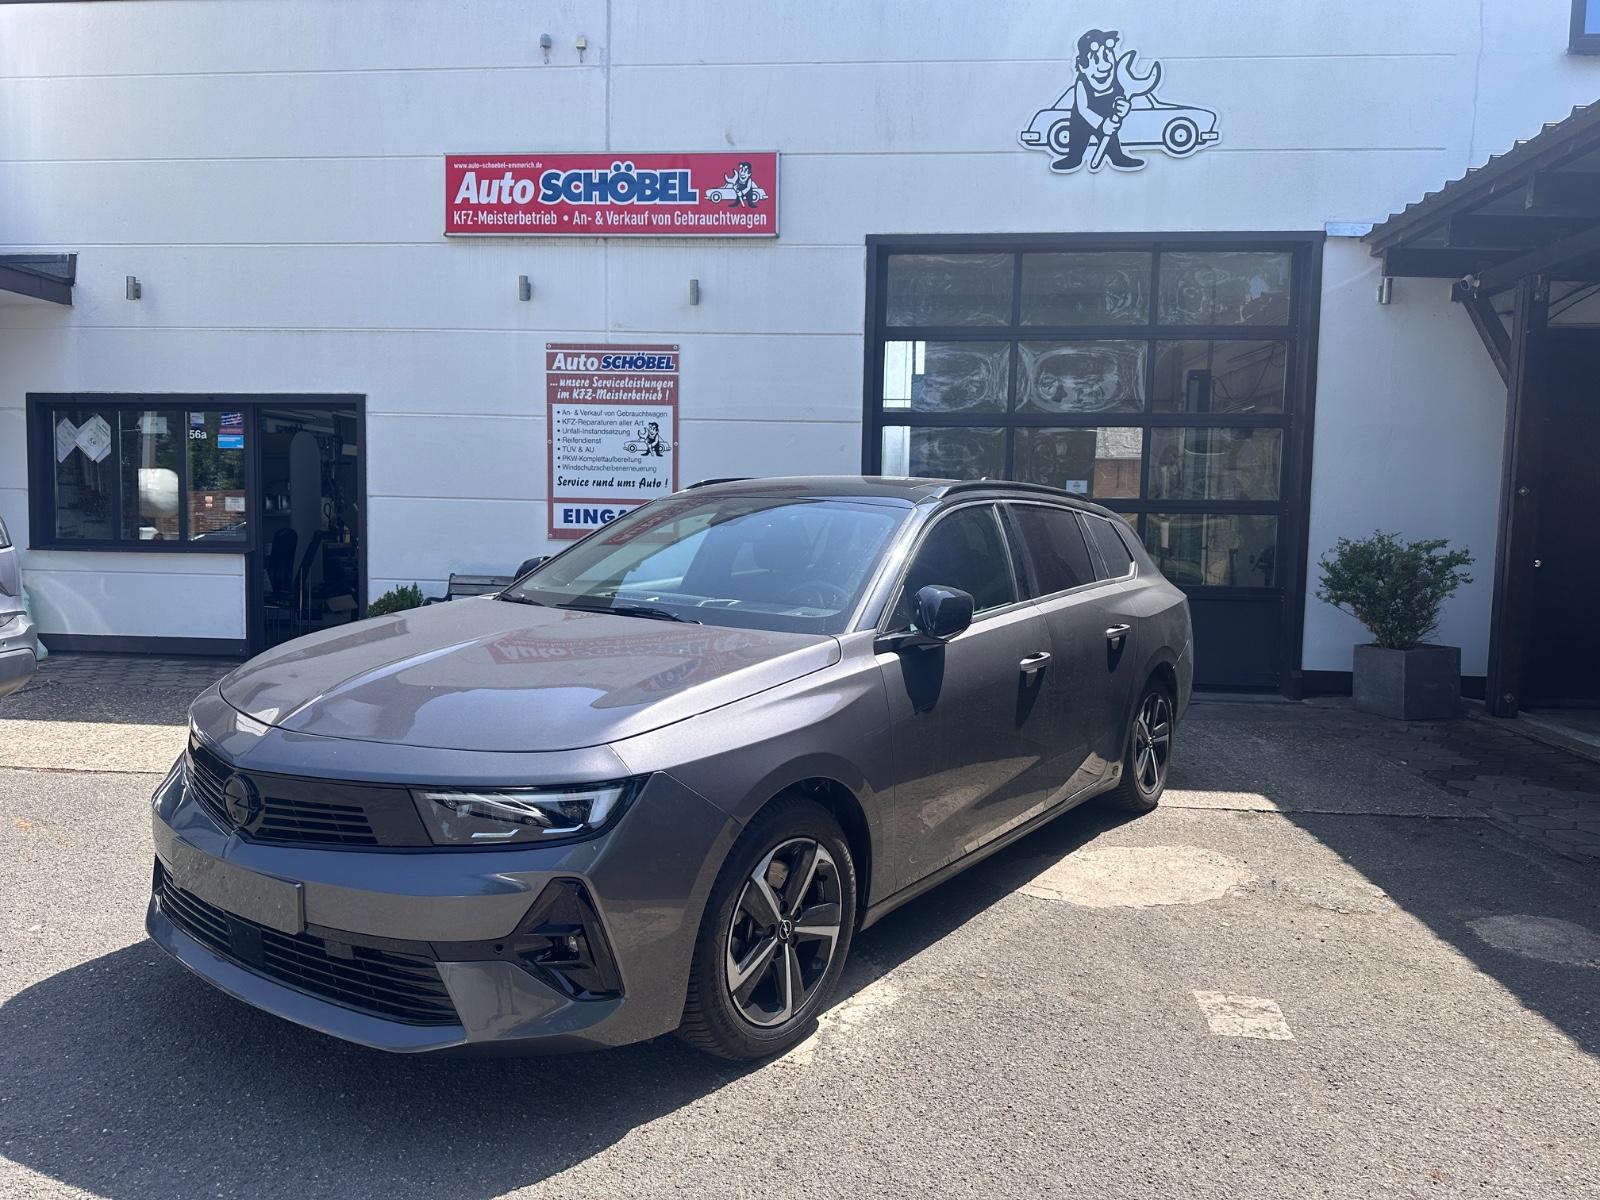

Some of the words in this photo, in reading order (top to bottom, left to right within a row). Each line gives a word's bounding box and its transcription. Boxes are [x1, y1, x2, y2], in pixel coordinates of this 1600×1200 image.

[453, 161, 542, 169] www.auto-schoebel-emmerich.de
[454, 171, 535, 205] Auto
[537, 160, 699, 205] SCHÖBEL
[453, 210, 558, 225] KFZ-Meisterbetrieb
[572, 210, 592, 225] An-
[595, 210, 604, 225] &
[606, 210, 649, 225] Verkauf
[651, 213, 671, 226] von
[674, 210, 767, 229] Gebrauchtwagen
[552, 352, 599, 371] Auto
[601, 352, 676, 371] SCHÖBEL
[559, 378, 590, 388] unsere
[592, 376, 674, 390] Serviceleistungen
[557, 388, 570, 399] im
[572, 388, 663, 401] KFZ-Meisterbetrieb
[580, 409, 603, 417] Verkauf
[616, 409, 668, 419] Gebrauchtwagen
[562, 418, 618, 427] KFZ-Reparaturen
[618, 419, 633, 427] aller
[634, 419, 644, 427] Art
[189, 429, 208, 440] 56a
[562, 427, 631, 437] Unfall-Instandsetzung
[562, 445, 577, 453] TÜV
[557, 475, 590, 487] Service
[592, 476, 615, 488] rund
[616, 479, 636, 488] ums
[638, 477, 662, 489] Auto
[664, 477, 669, 488] !
